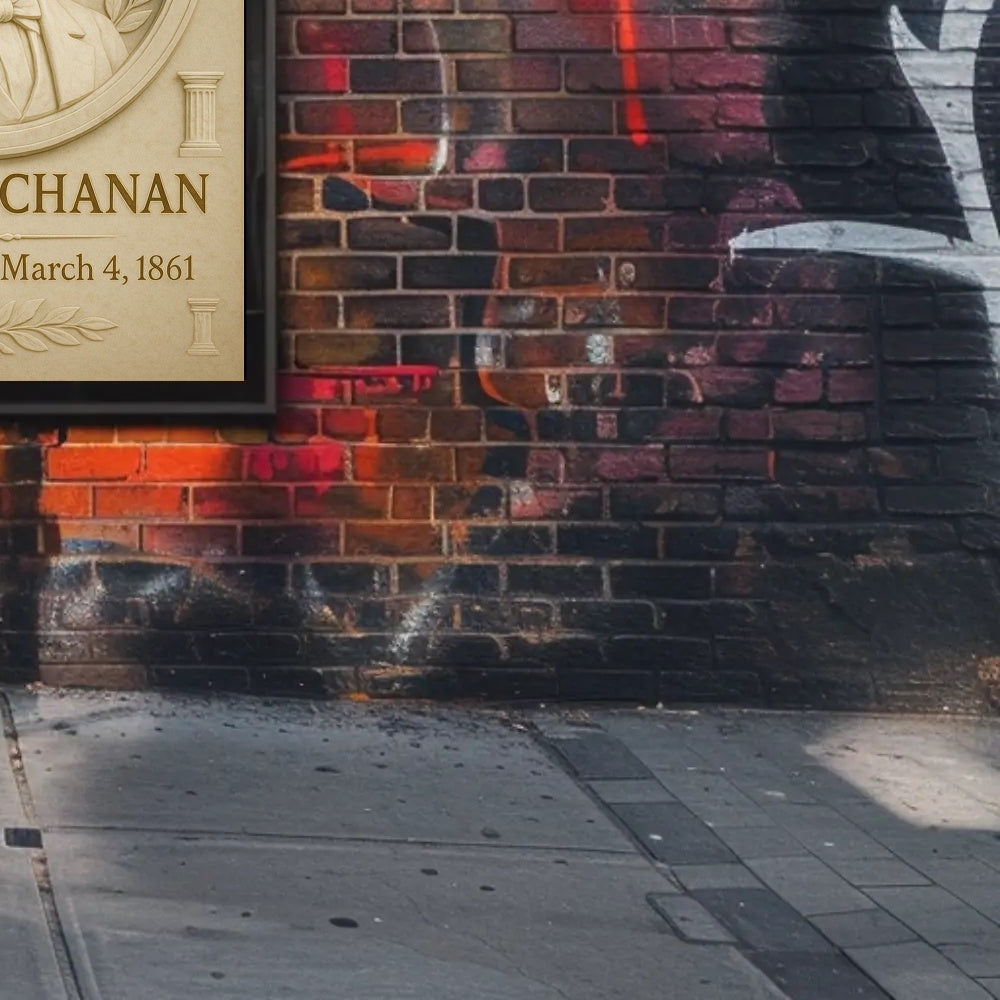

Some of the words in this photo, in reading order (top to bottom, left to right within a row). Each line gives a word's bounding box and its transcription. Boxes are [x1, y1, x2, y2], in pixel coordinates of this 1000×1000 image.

[0, 253, 95, 281] March
[102, 254, 128, 285] 4,
[136, 254, 196, 281] 1861
